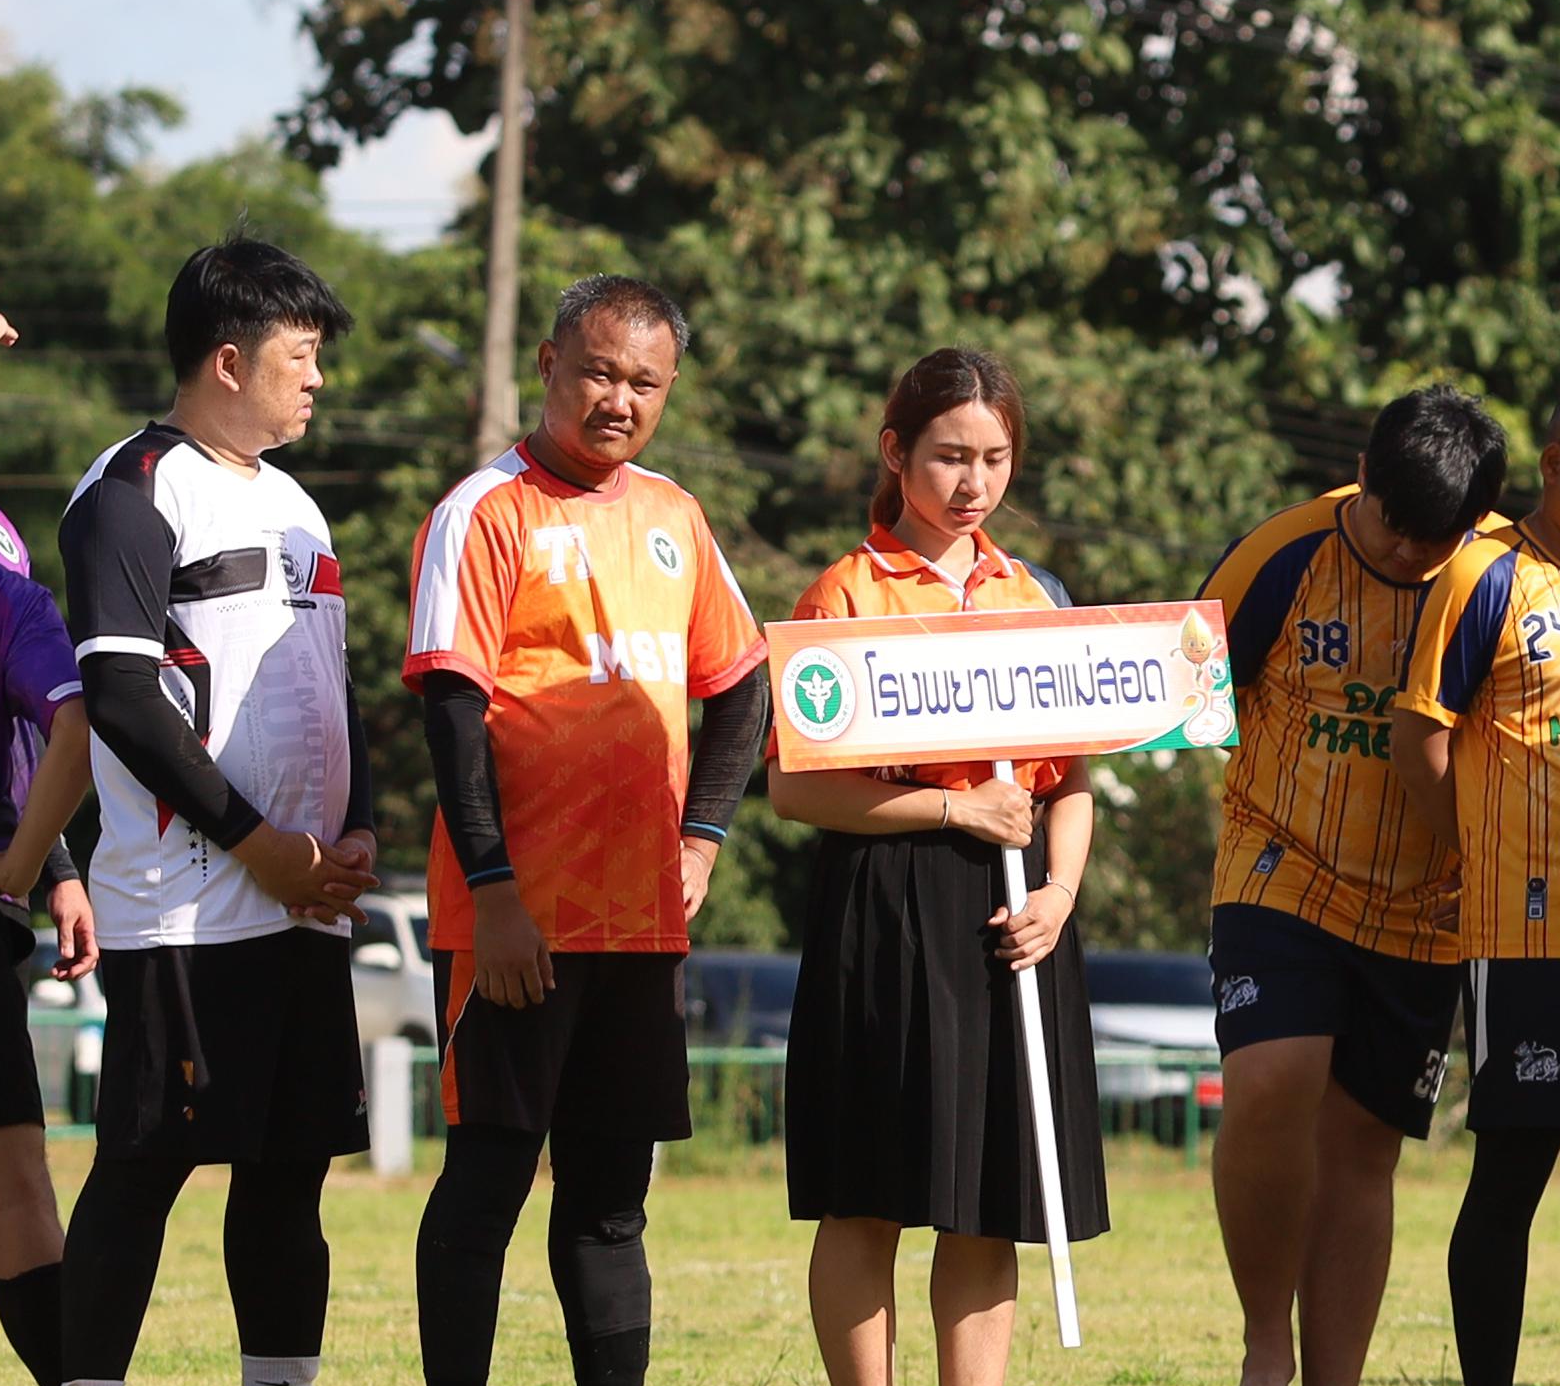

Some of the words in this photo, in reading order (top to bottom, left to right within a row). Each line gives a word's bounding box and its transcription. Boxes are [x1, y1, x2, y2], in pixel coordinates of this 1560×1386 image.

[864, 644, 1168, 719] โรงพยาบาลแม่สอด
